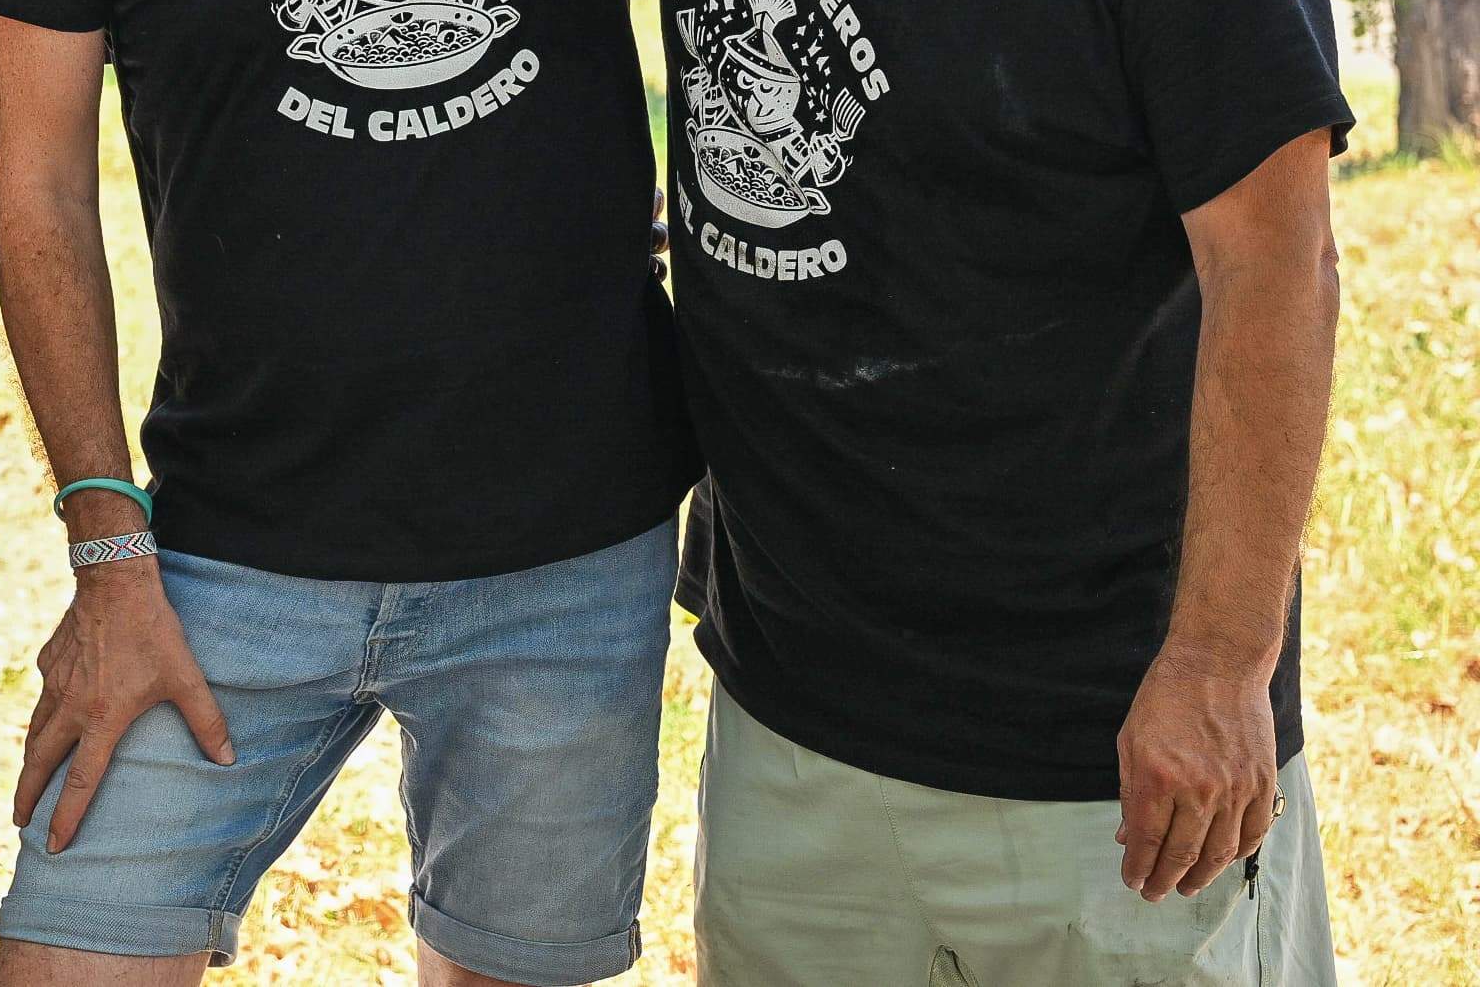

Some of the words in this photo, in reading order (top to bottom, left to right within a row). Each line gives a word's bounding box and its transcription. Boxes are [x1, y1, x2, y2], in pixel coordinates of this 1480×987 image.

[277, 87, 356, 140] DEL
[367, 48, 540, 142] CALDERO
[677, 170, 694, 235] EL
[701, 221, 848, 281] CALDERO
